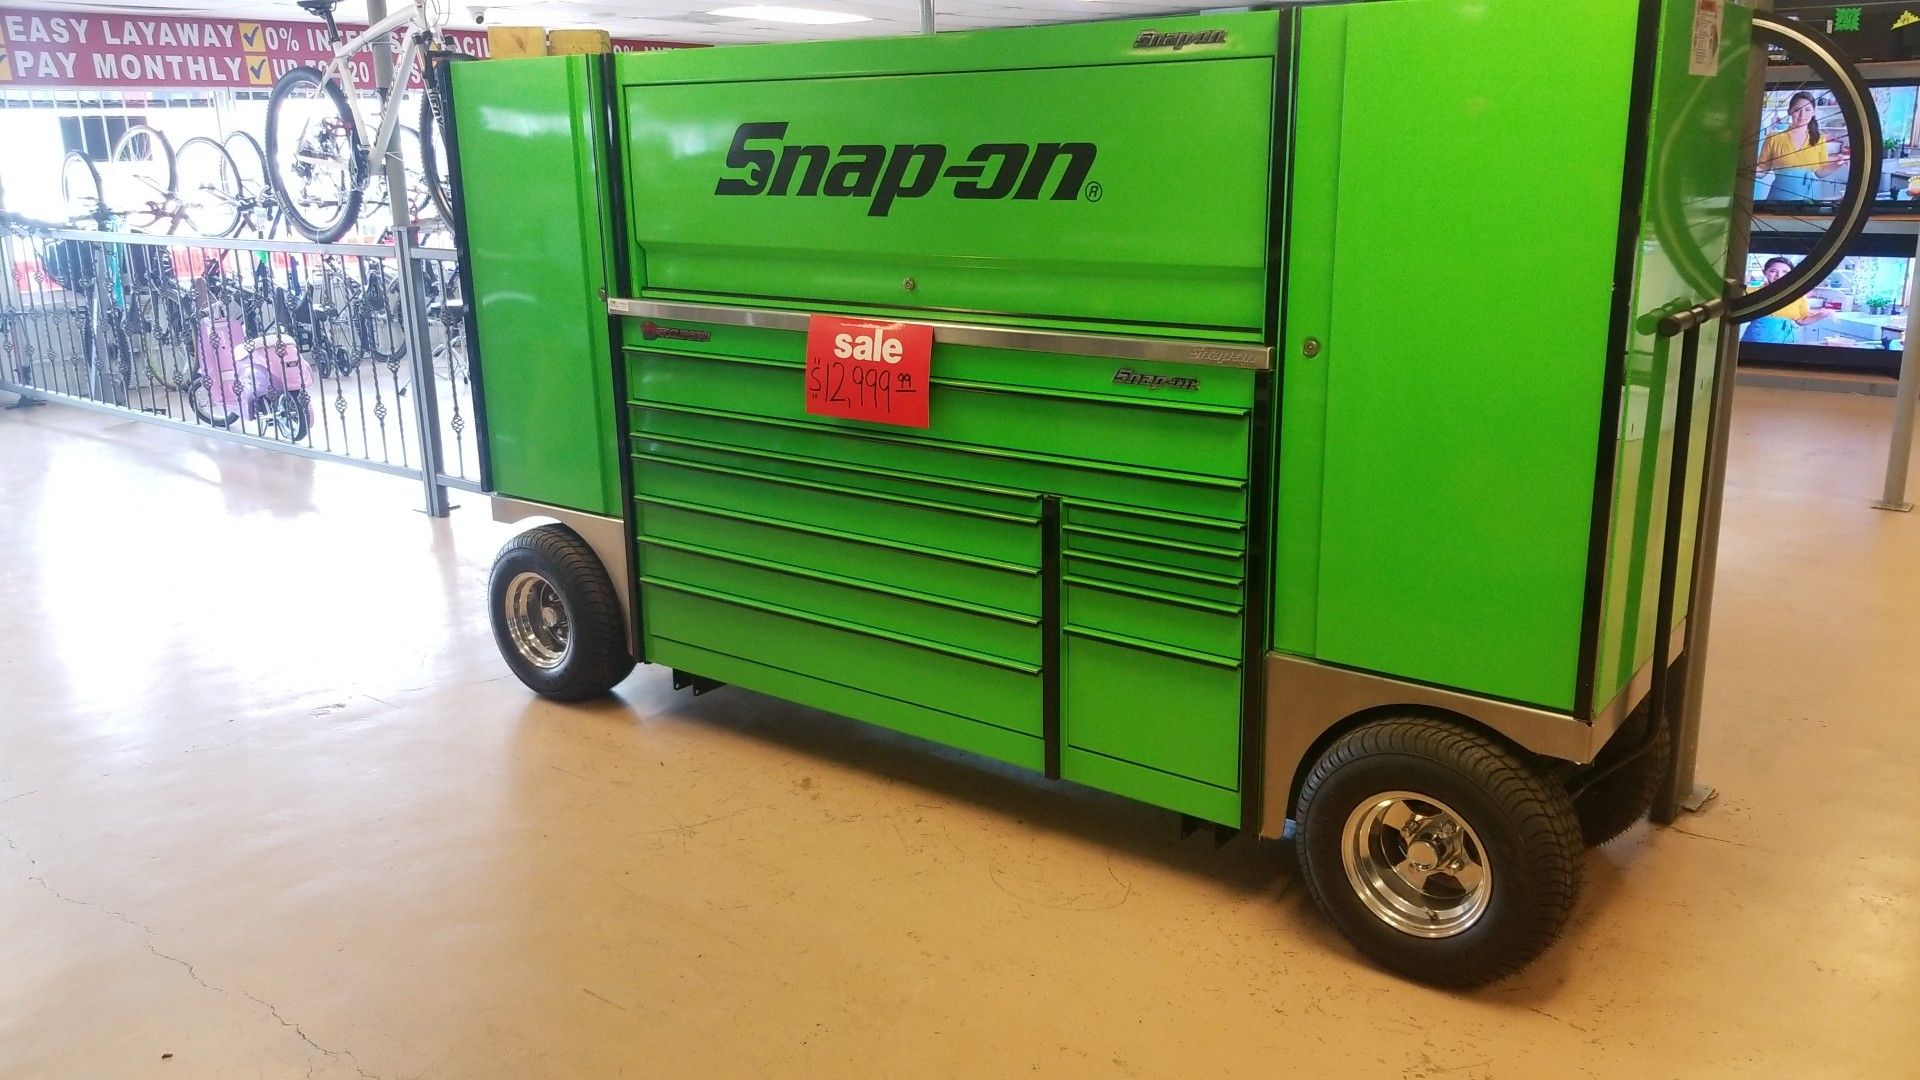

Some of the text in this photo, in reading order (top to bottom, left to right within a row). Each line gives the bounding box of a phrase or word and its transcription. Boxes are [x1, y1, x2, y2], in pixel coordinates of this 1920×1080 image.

[5, 16, 88, 43] EASY
[102, 20, 234, 48] LAYAWAY
[265, 27, 300, 51] 0%
[15, 50, 77, 78] PAY
[92, 53, 242, 82] MONTHLY
[714, 121, 1098, 217] Snap-on
[834, 328, 903, 364] sale
